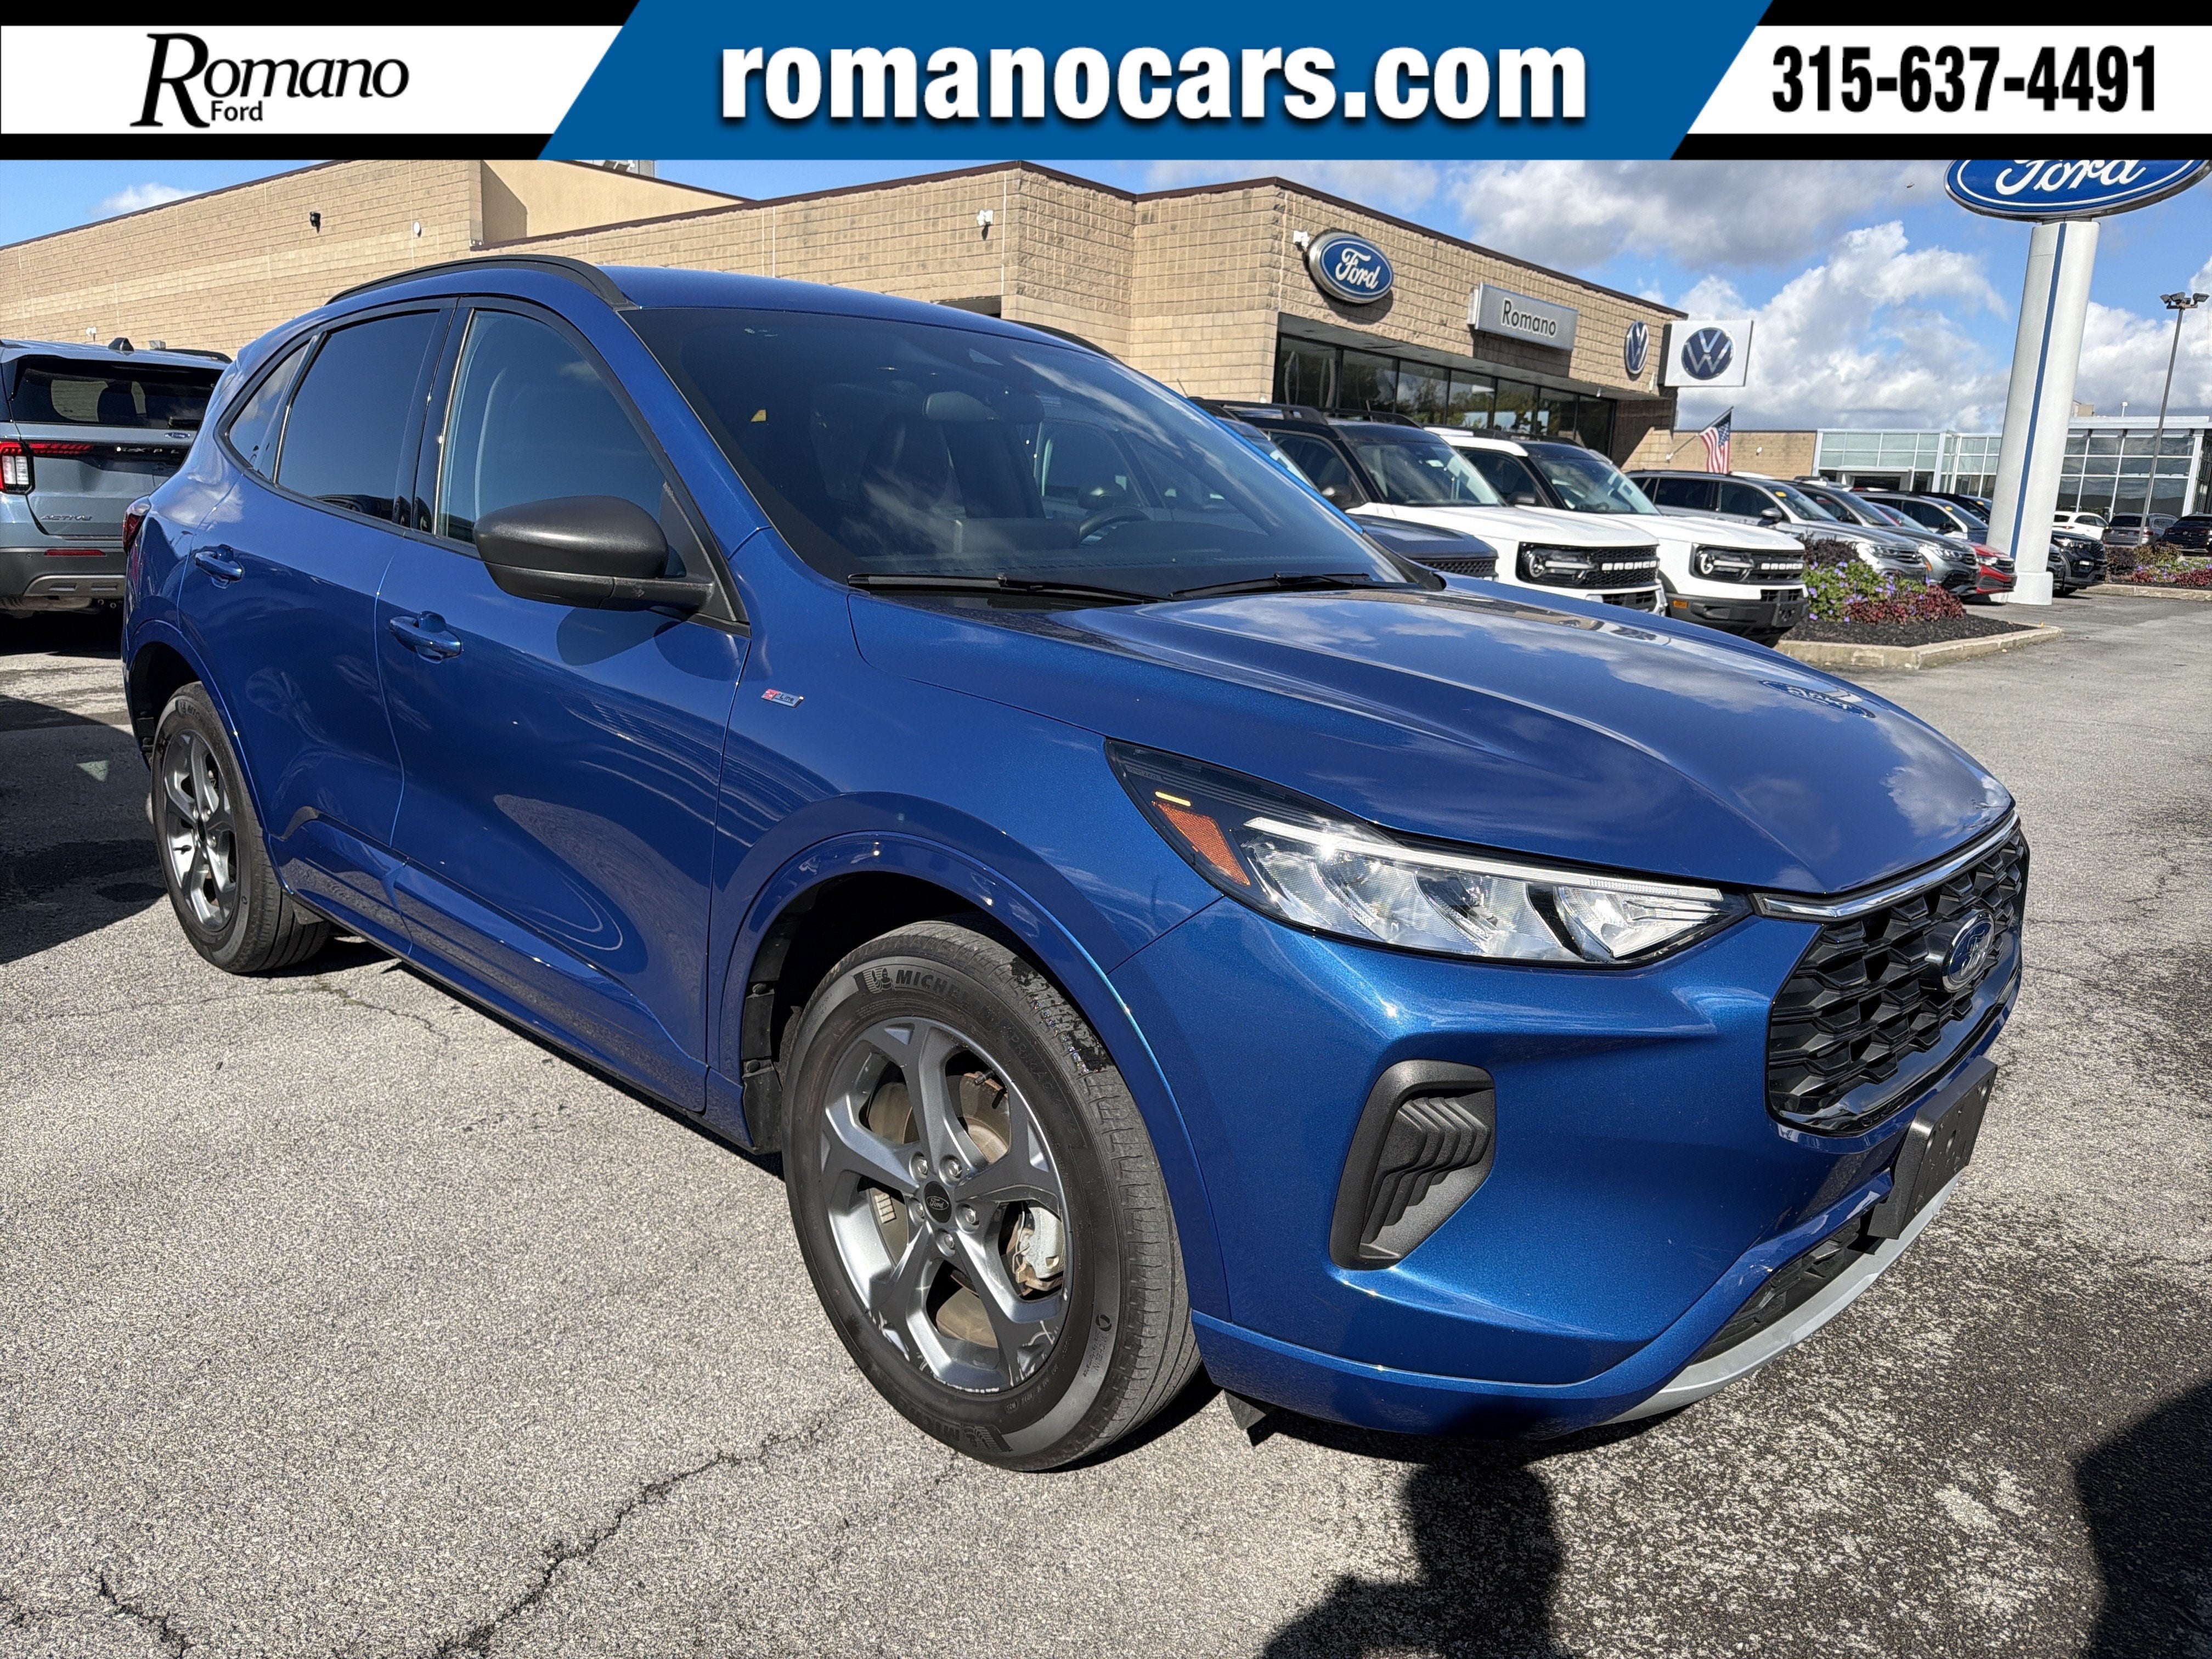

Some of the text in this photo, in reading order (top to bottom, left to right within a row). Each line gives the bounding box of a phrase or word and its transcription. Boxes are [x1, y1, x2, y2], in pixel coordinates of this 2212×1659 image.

[1335, 248, 1380, 289] Ford
[1502, 299, 1556, 336] Romano
[1601, 560, 1657, 571] BRONCO
[930, 1197, 945, 1208] Ford
